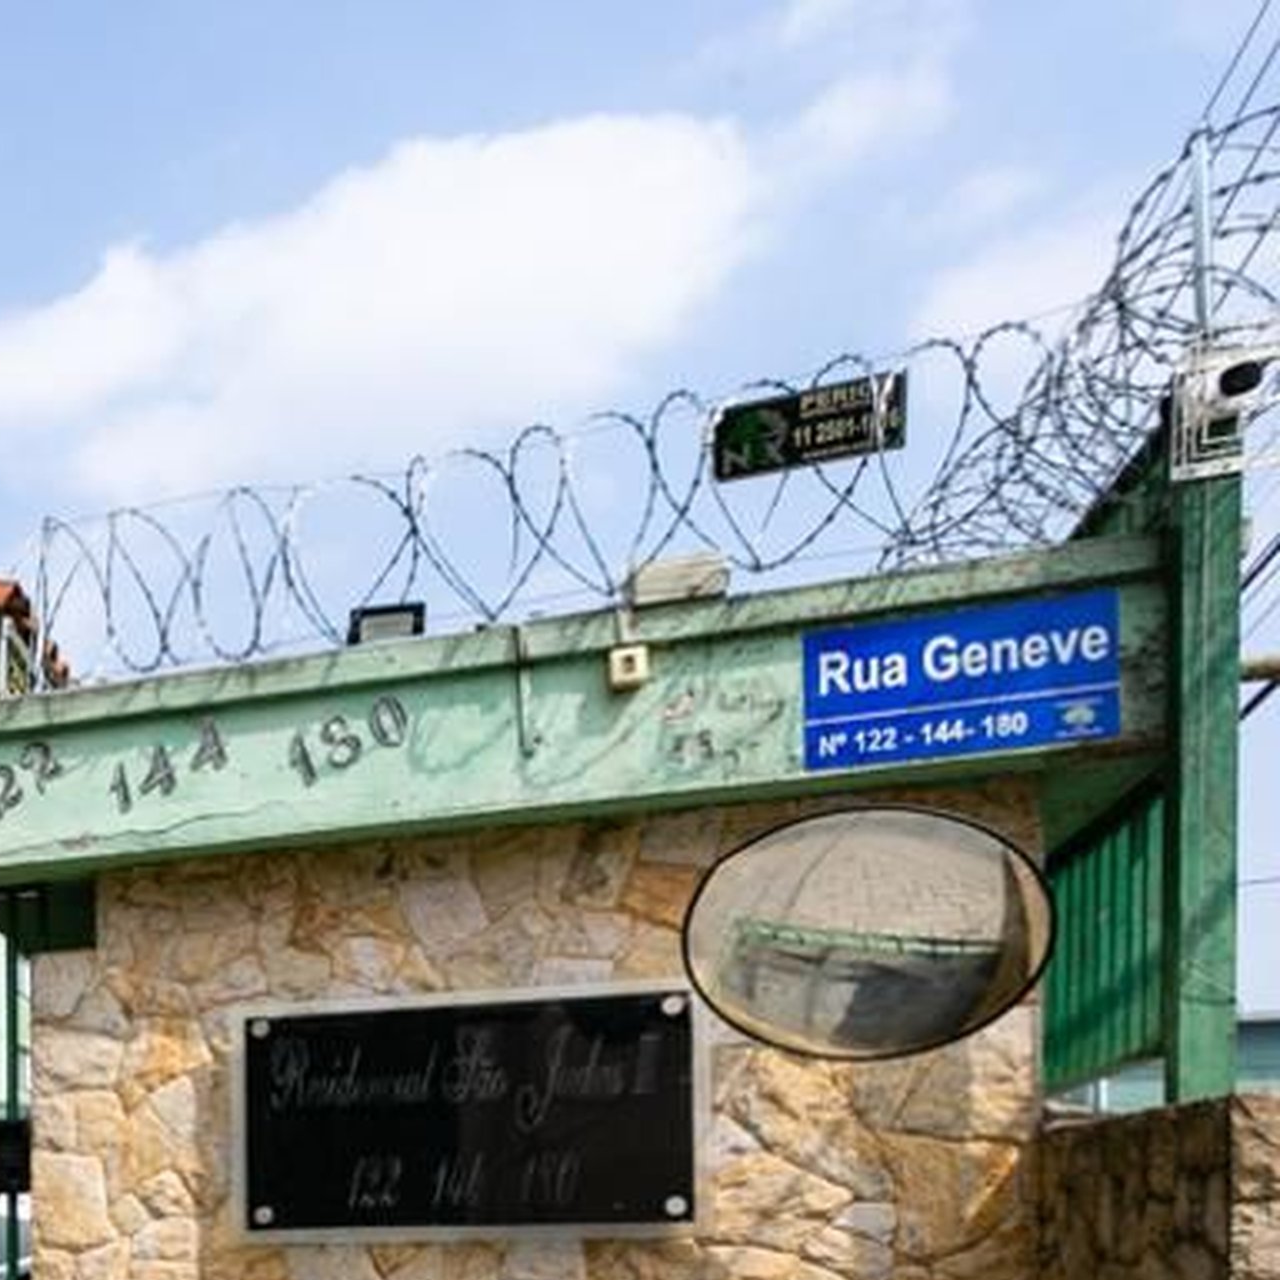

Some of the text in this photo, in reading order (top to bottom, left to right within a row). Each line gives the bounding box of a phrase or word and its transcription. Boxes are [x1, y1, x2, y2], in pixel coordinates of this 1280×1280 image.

[818, 624, 1109, 696] Rua Geneve
[109, 713, 229, 814] 144
[288, 694, 408, 788] 180
[854, 726, 899, 753] 122
